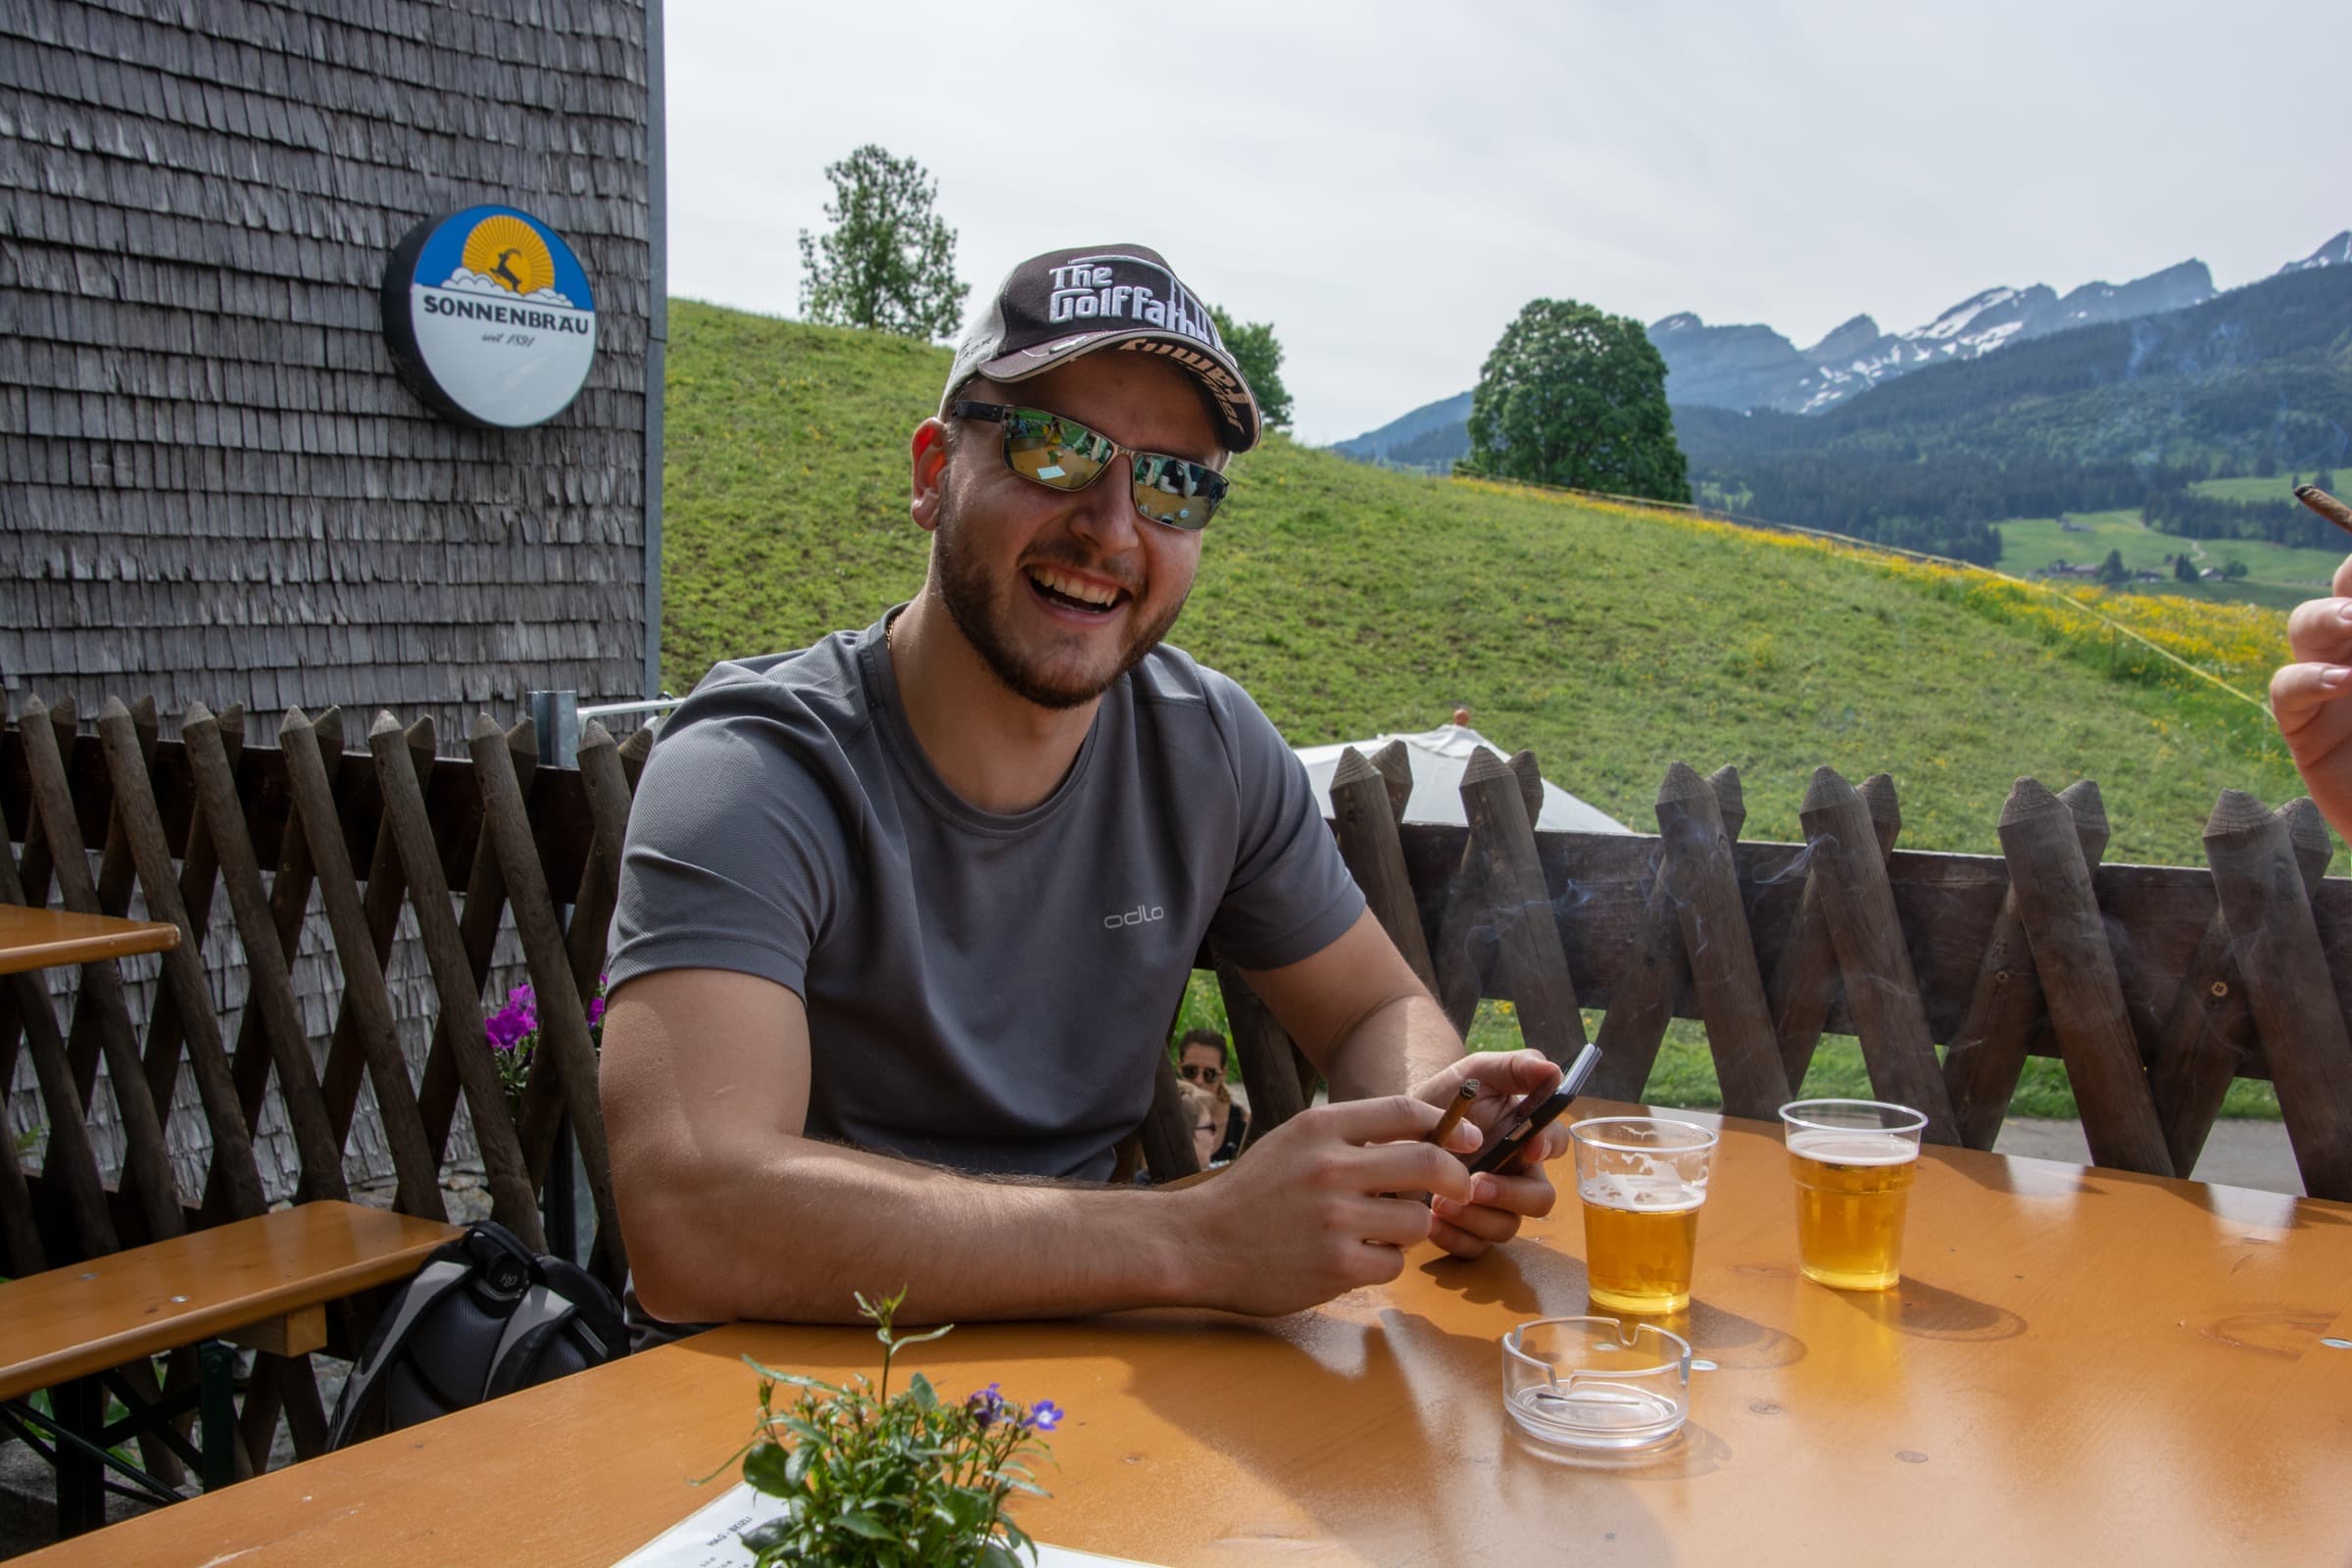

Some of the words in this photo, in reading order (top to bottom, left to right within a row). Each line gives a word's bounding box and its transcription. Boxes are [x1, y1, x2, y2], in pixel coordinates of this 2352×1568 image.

[1049, 264, 1113, 289] The
[423, 295, 589, 335] SONNENBRÄU
[481, 331, 504, 343] seit
[506, 333, 536, 348] 1891
[1103, 904, 1164, 929] odlo
